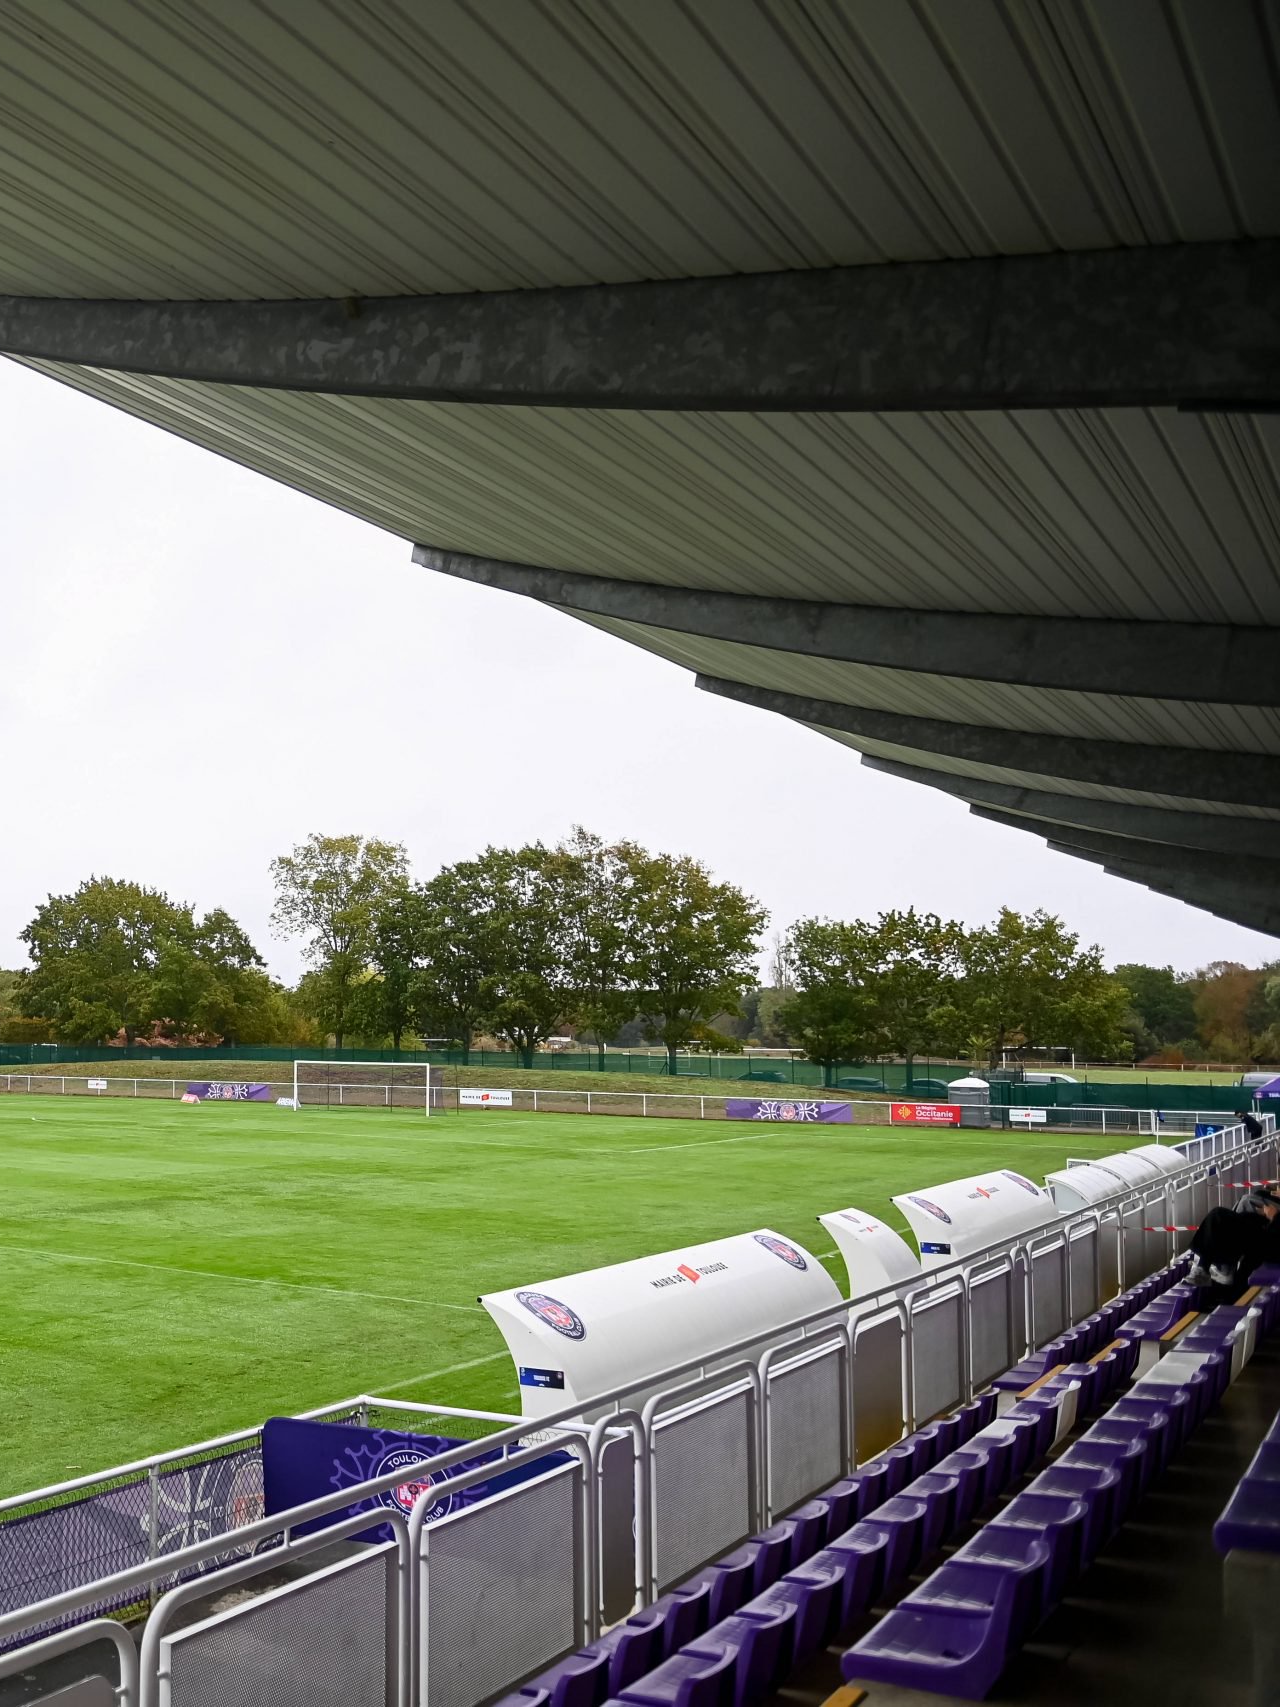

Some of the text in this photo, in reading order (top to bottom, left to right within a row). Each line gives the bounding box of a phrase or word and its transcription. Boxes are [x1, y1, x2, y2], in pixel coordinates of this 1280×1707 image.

[915, 1110, 954, 1118] Occitanie
[650, 1277, 677, 1288] MAIRIE
[696, 1262, 728, 1275] TOULOUSE
[426, 1506, 444, 1523] CLUB
